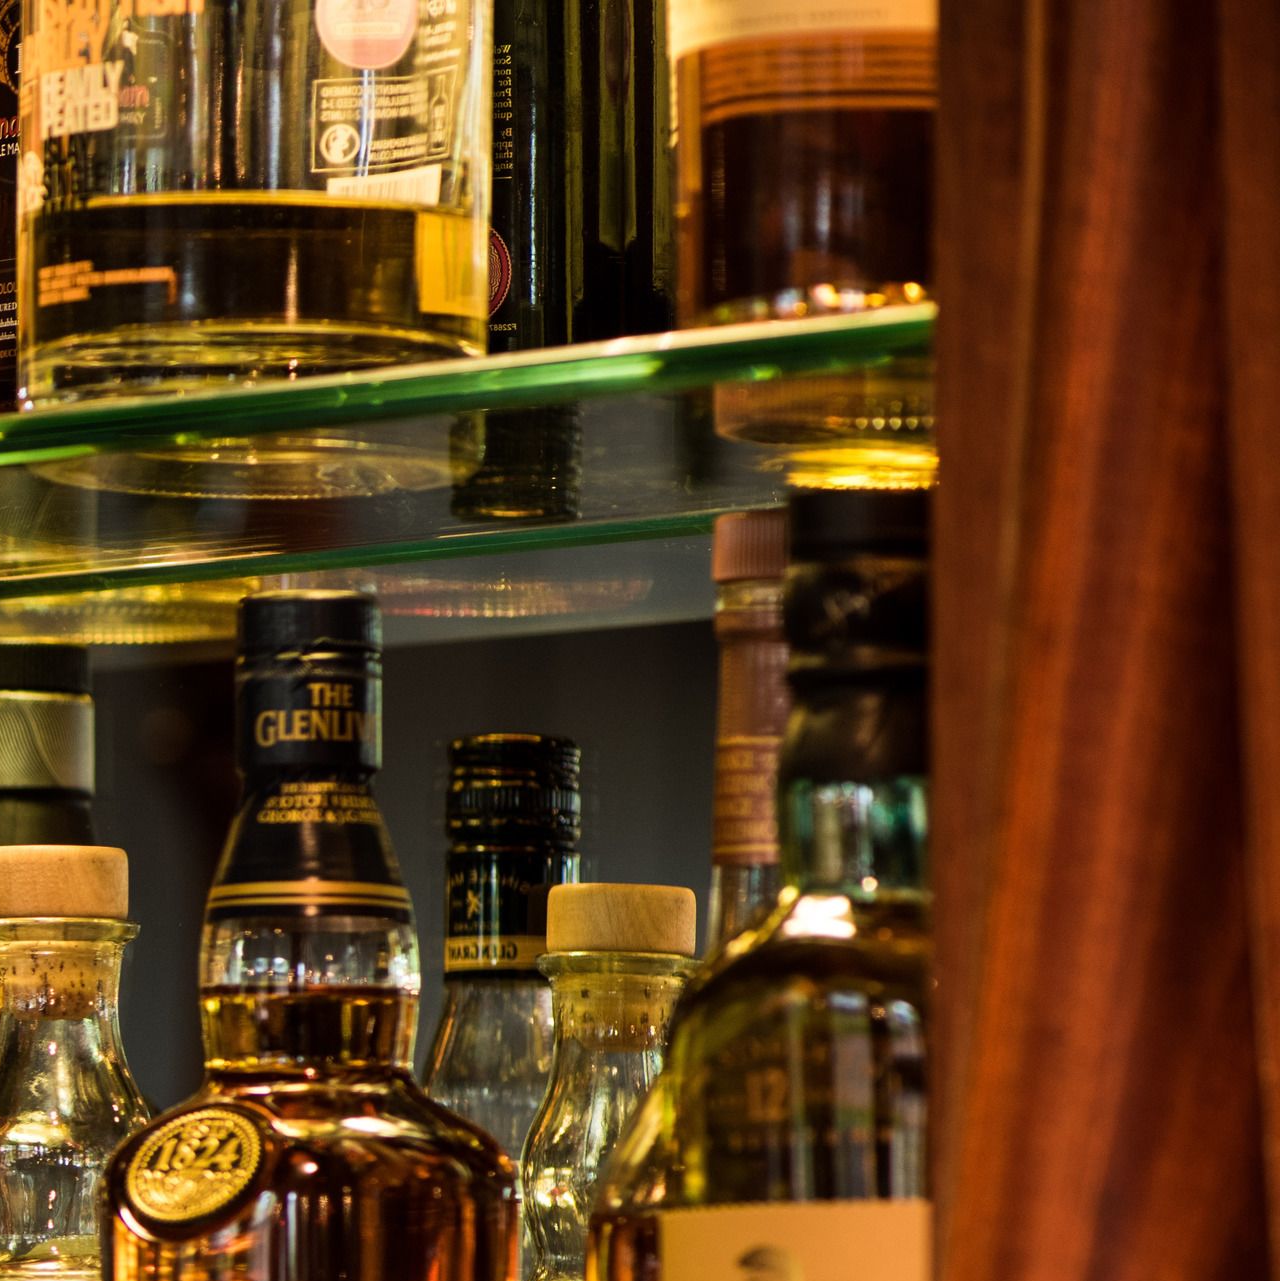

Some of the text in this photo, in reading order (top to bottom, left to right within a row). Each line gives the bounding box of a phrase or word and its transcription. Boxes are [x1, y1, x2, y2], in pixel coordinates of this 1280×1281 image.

[40, 60, 125, 101] HEAVILY
[40, 94, 119, 140] PEATED
[307, 682, 353, 707] THE
[154, 1135, 241, 1172] 1824
